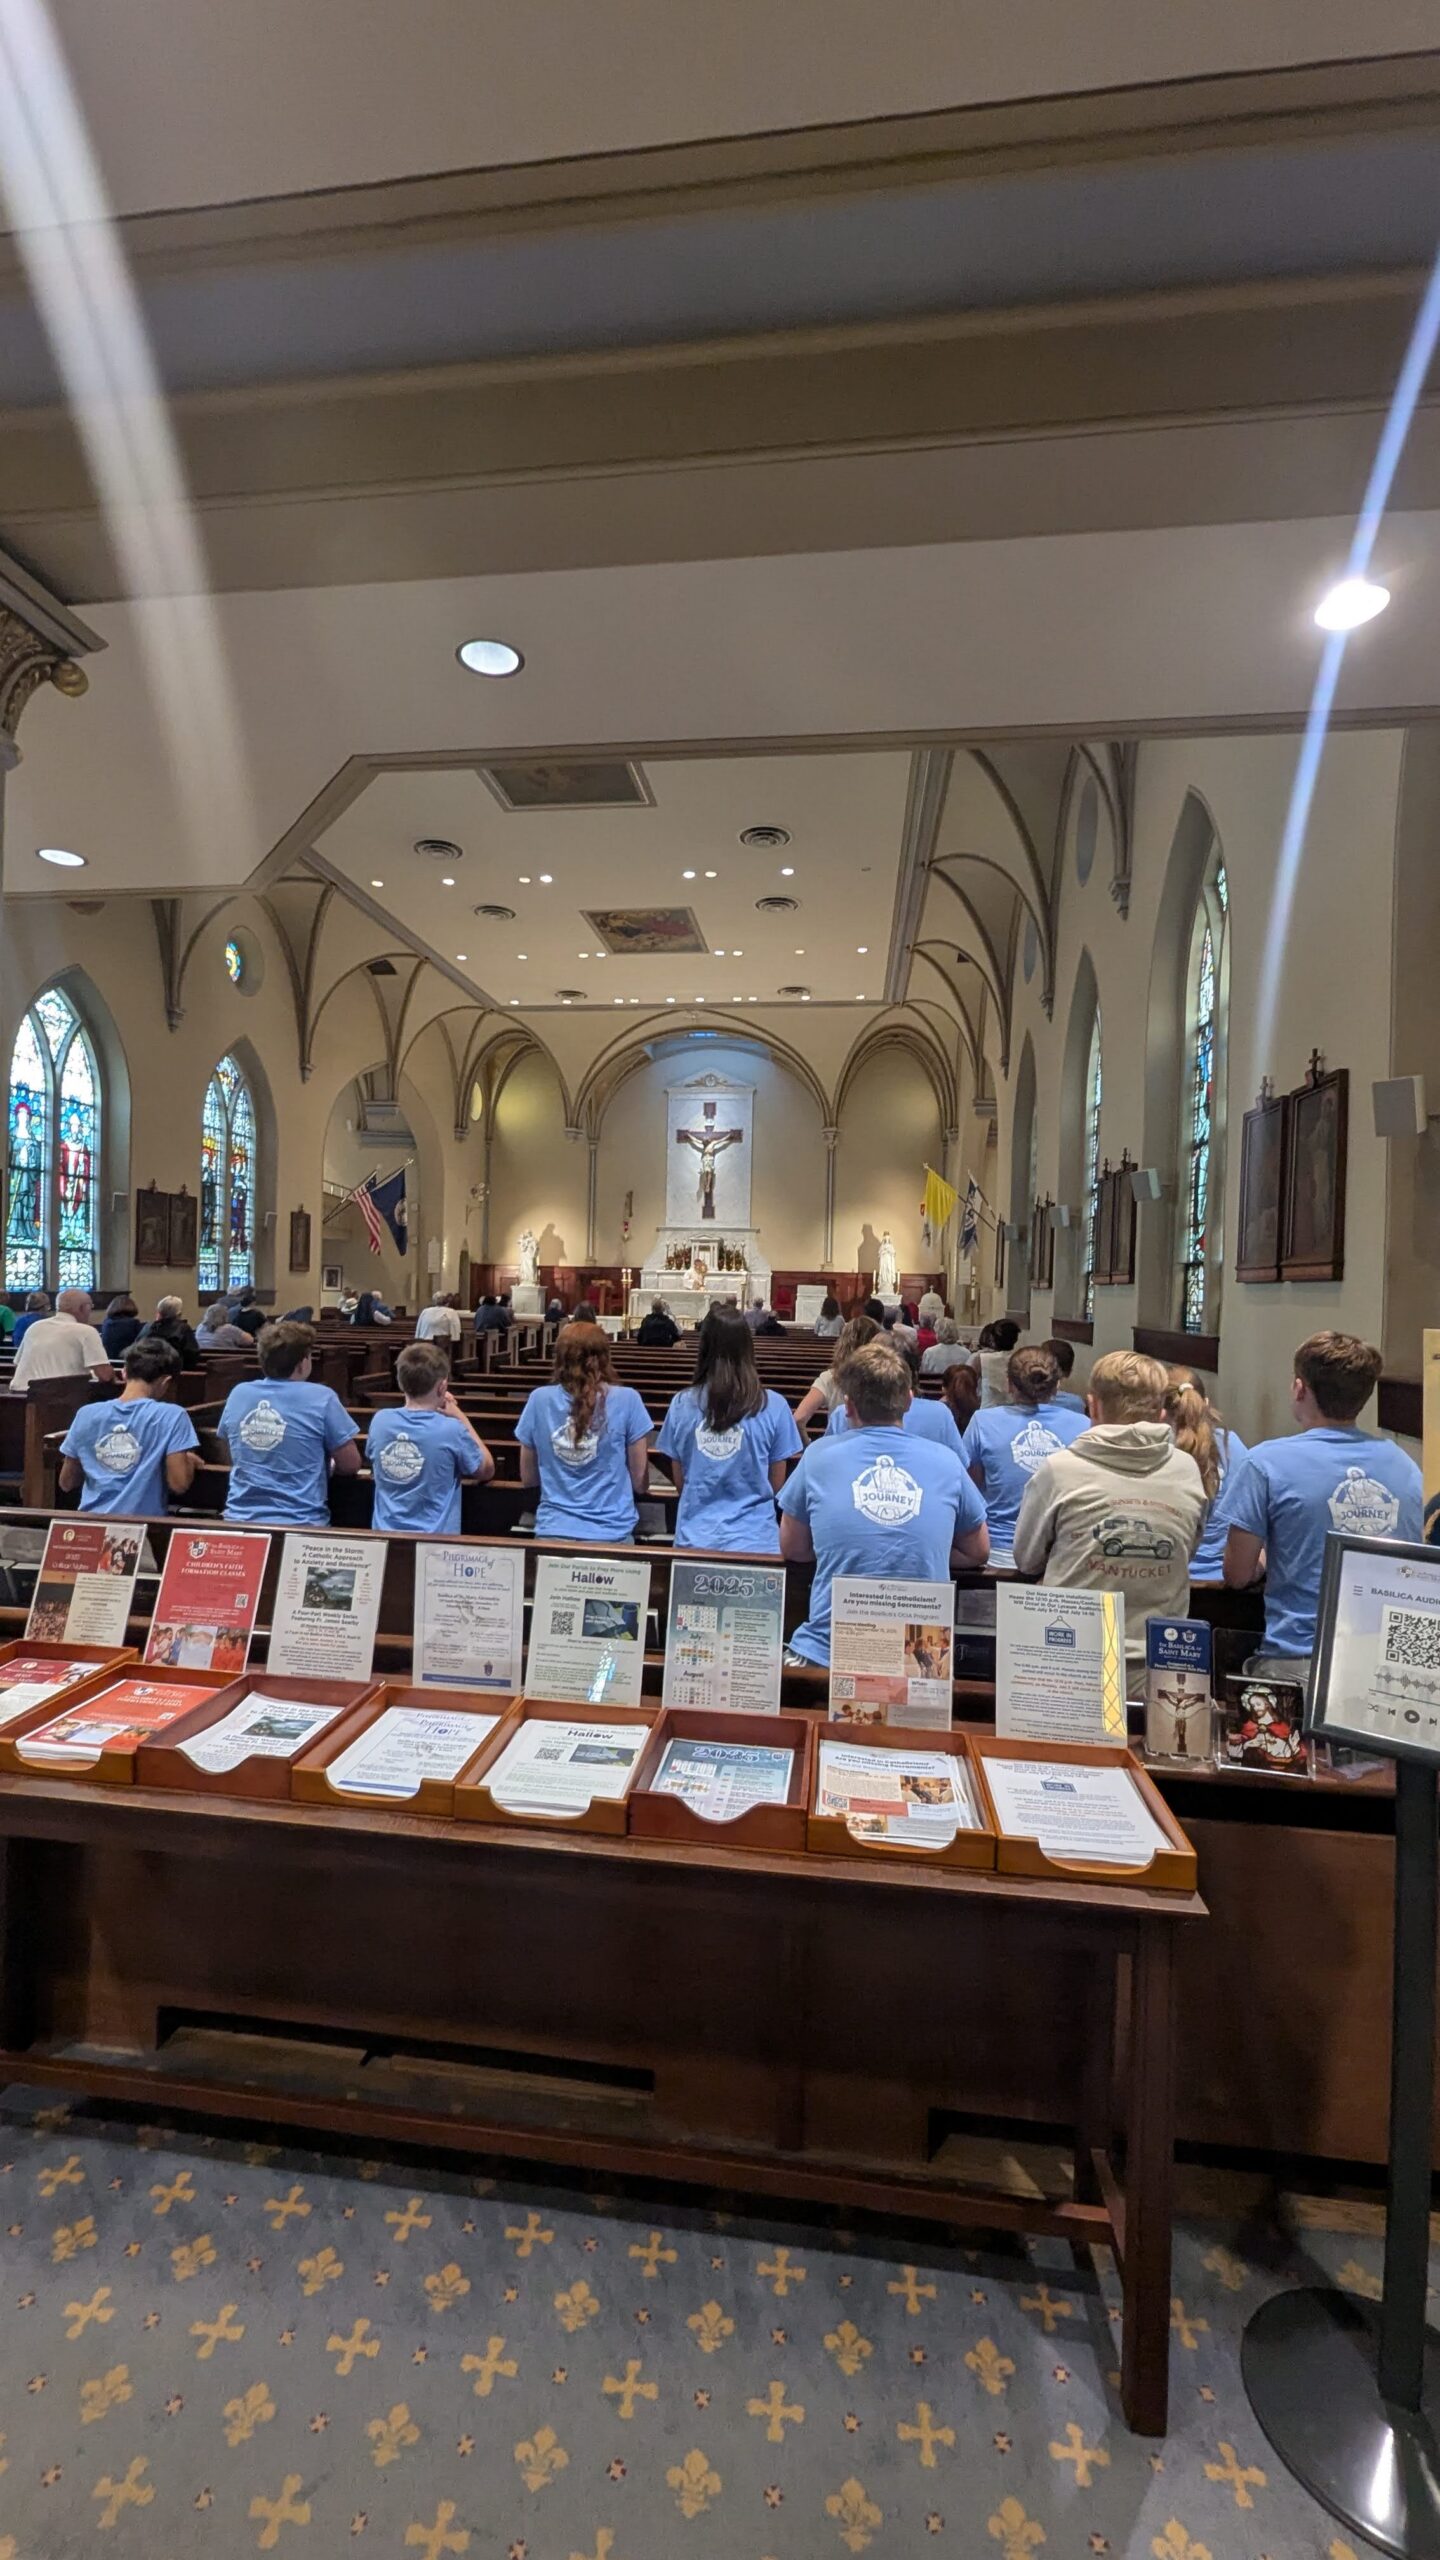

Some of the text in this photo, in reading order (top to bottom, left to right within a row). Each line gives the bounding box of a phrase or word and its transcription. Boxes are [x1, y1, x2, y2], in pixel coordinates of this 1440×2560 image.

[863, 1492, 914, 1506] JOURNEY
[1341, 1509, 1391, 1520] JOURNEY
[443, 1550, 496, 1570] PILGRIMAGE of
[454, 1563, 486, 1578] HOPE
[1088, 1557, 1172, 1578] NANTUCKET
[571, 1571, 614, 1585] Hallow
[694, 1574, 755, 1597] 2025
[849, 1592, 884, 1600] Interested
[892, 1594, 936, 1603] Catholicism?
[1371, 1588, 1440, 1605] BASILICA AUDI
[870, 1600, 896, 1608] missing
[898, 1602, 942, 1610] Sacraments?
[1168, 1642, 1195, 1650] BASILICA
[1181, 1650, 1201, 1658] MARY
[683, 1670, 704, 1678] August
[567, 1730, 613, 1740] Hallow
[692, 1746, 759, 1762] 2025
